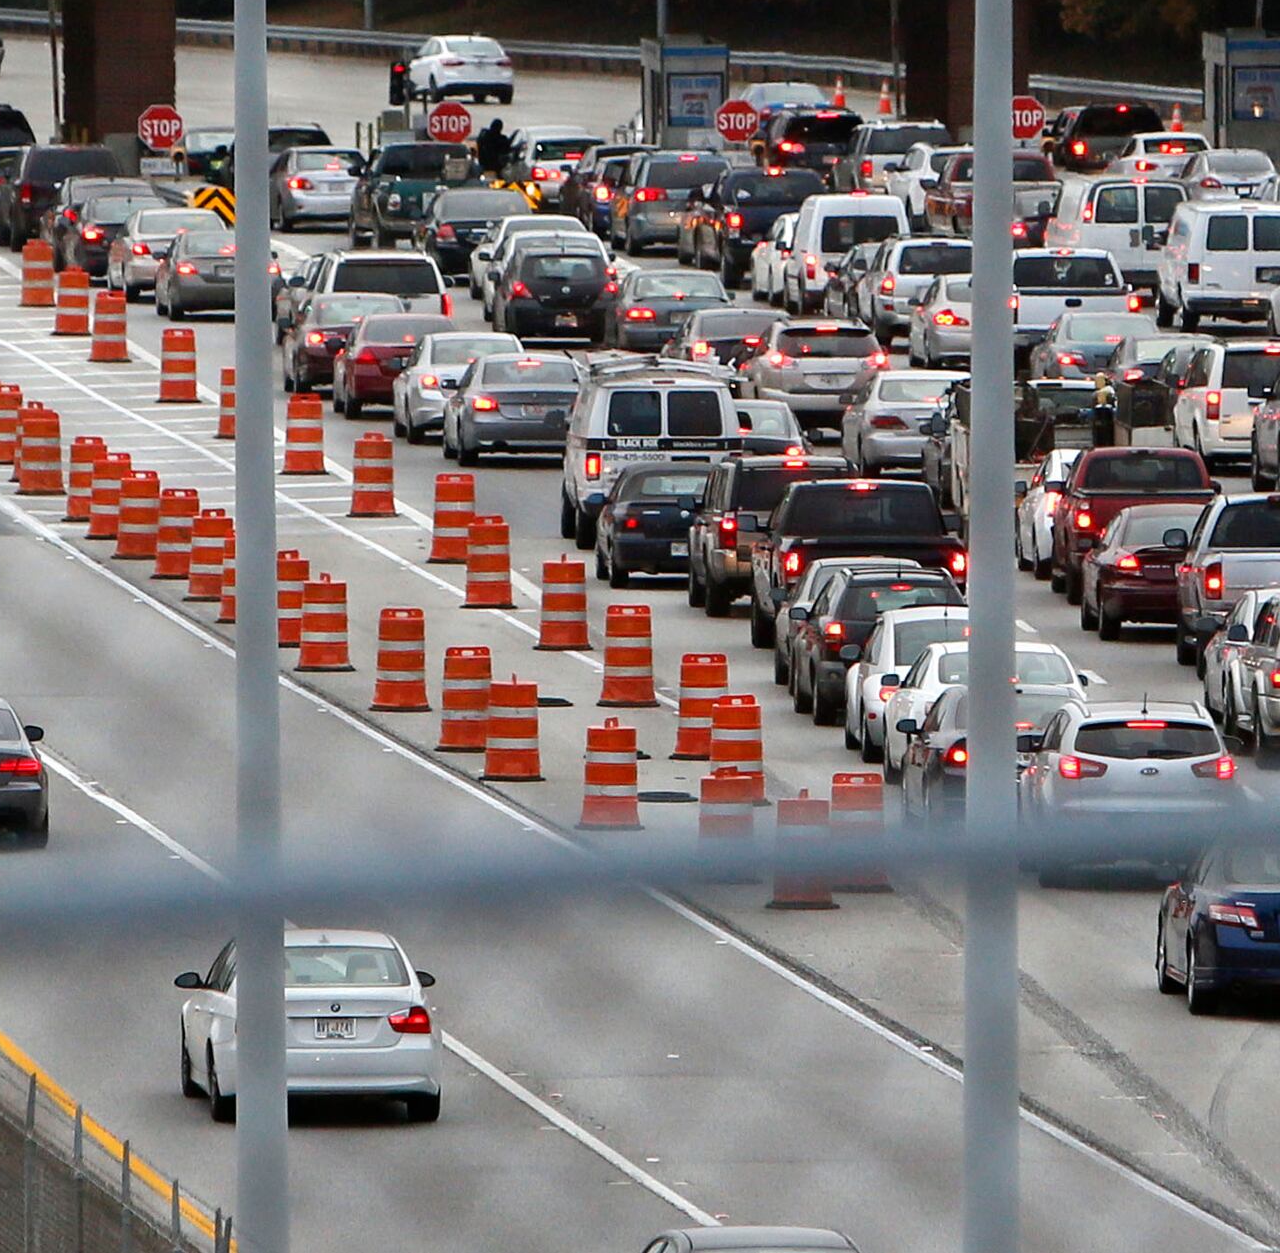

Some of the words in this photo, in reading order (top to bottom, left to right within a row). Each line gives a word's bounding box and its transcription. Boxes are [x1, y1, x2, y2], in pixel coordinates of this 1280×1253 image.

[431, 115, 469, 133] STOP
[718, 112, 756, 130] STOP
[1012, 110, 1043, 127] TOP
[142, 119, 181, 137] STOP
[616, 439, 641, 448] BLACK
[642, 439, 659, 448] BOX
